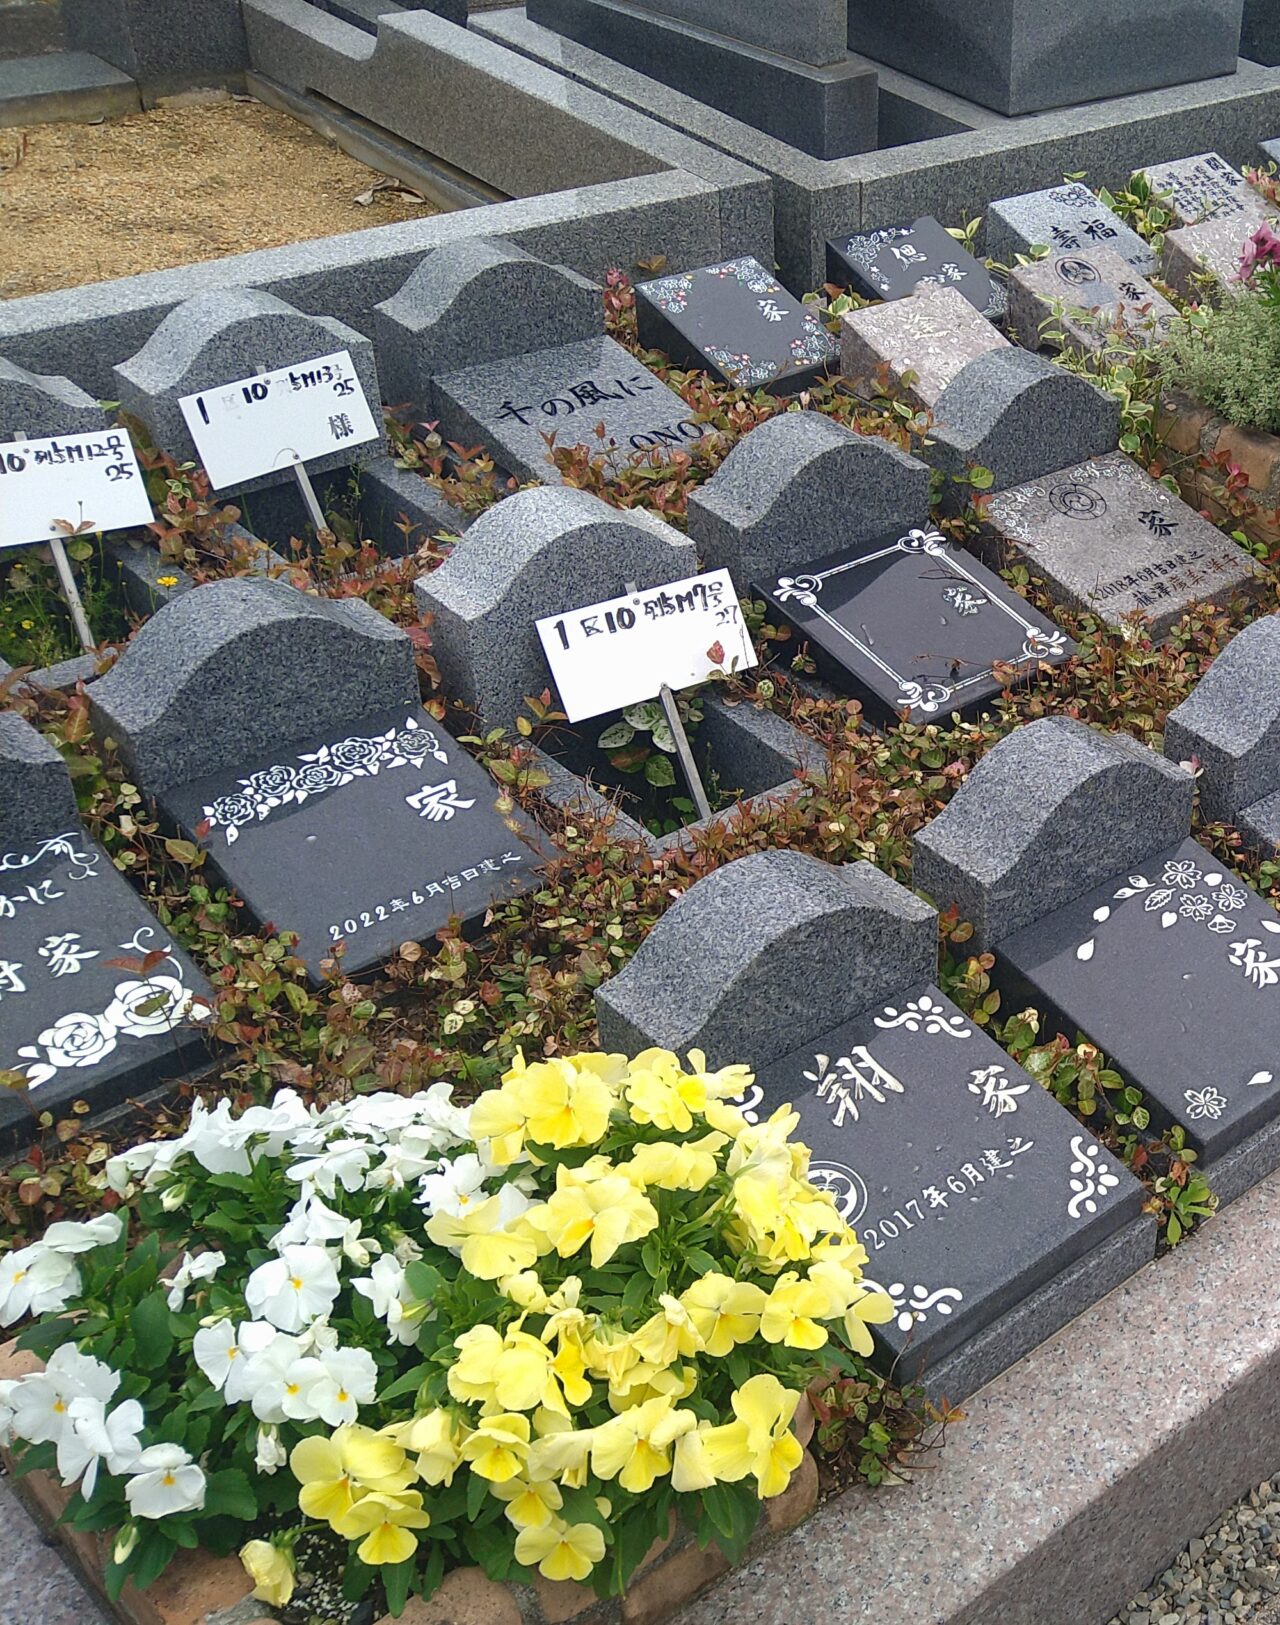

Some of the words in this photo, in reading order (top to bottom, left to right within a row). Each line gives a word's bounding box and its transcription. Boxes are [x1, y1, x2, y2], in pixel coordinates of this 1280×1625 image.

[1118, 281, 1147, 301] 家
[757, 299, 790, 322] 家
[333, 377, 355, 397] 25
[495, 376, 654, 426] 千の風に
[327, 413, 354, 440] 様
[105, 462, 133, 482] 25
[1138, 509, 1179, 538] 家
[942, 585, 989, 617] 家
[405, 779, 476, 822] 家
[329, 851, 522, 941] 2022年6月吉日建之
[38, 932, 101, 979] 家
[802, 1045, 905, 1127] 翔
[967, 1065, 1032, 1118] 家
[864, 1136, 1034, 1251] 2017年6月建之
